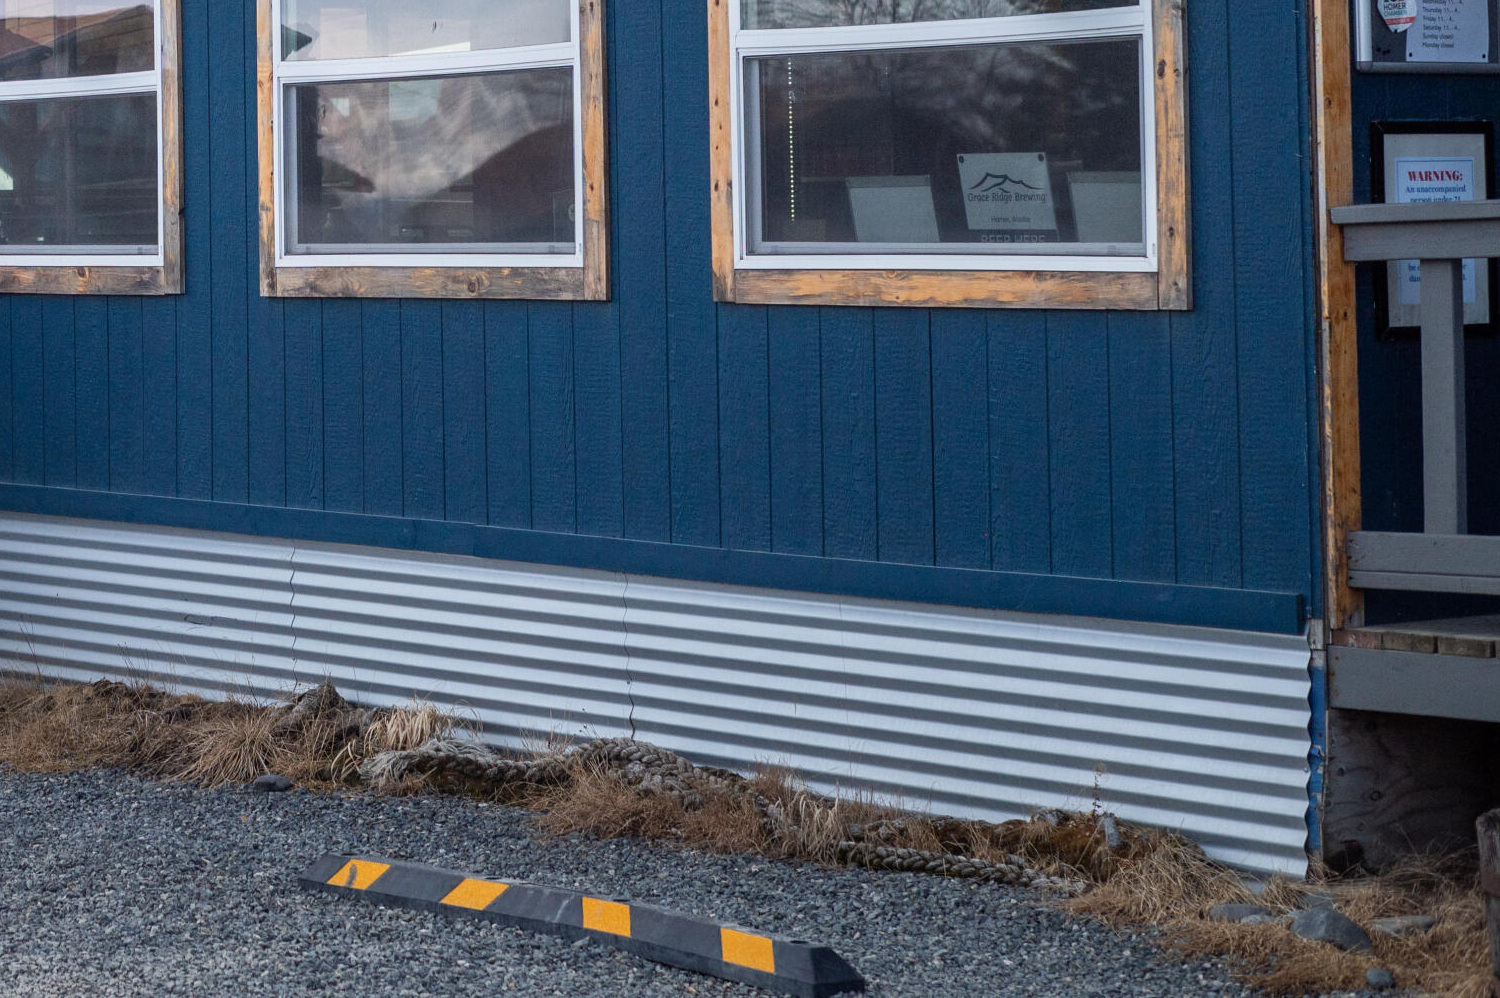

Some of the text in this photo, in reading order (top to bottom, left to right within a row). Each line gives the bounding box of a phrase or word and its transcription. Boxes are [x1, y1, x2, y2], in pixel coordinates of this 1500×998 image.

[1383, 2, 1406, 11] HOMER
[1408, 170, 1463, 182] WARNING:
[1406, 184, 1466, 194] An unaccompanied
[1015, 193, 1046, 204] Brewing
